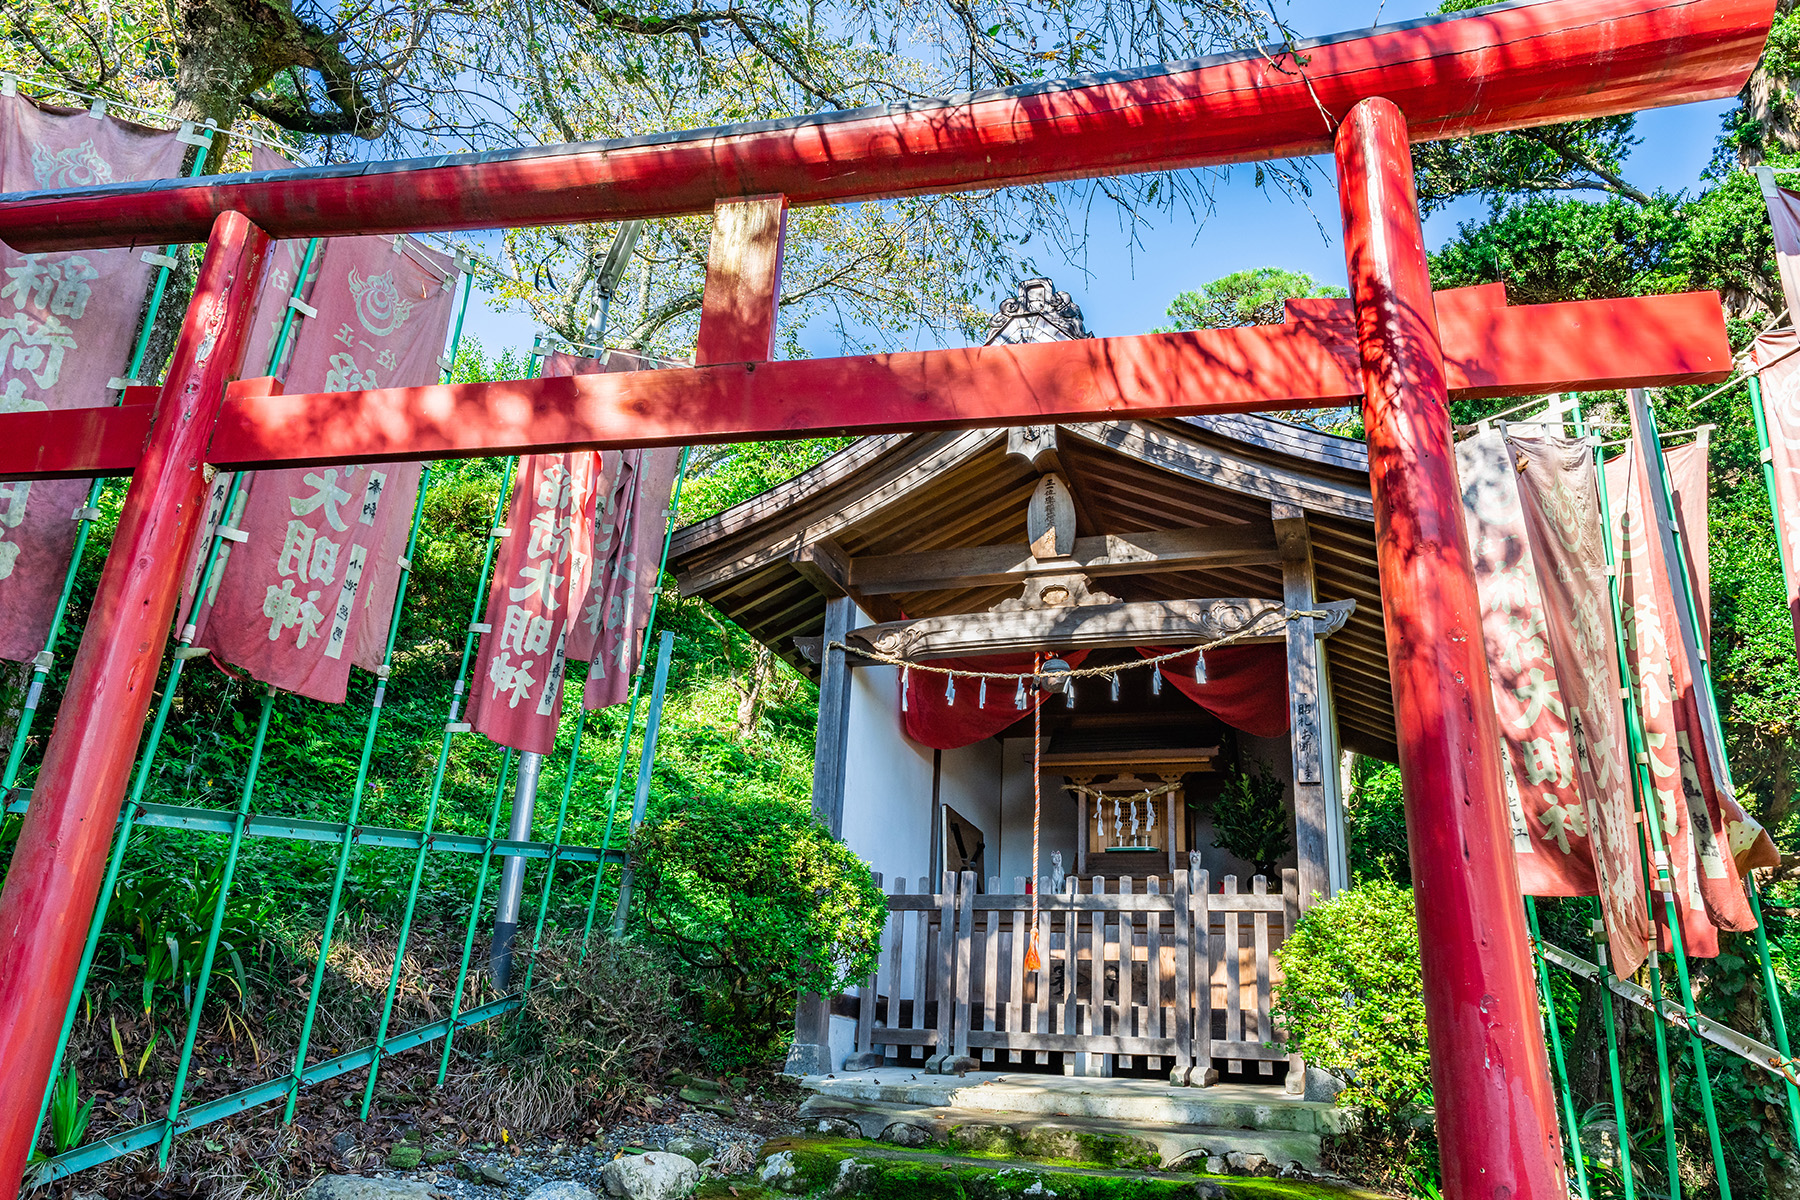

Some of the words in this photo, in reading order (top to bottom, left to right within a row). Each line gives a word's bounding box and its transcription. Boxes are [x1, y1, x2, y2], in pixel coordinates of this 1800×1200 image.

[1570, 589, 1637, 925] 稲荷大明神
